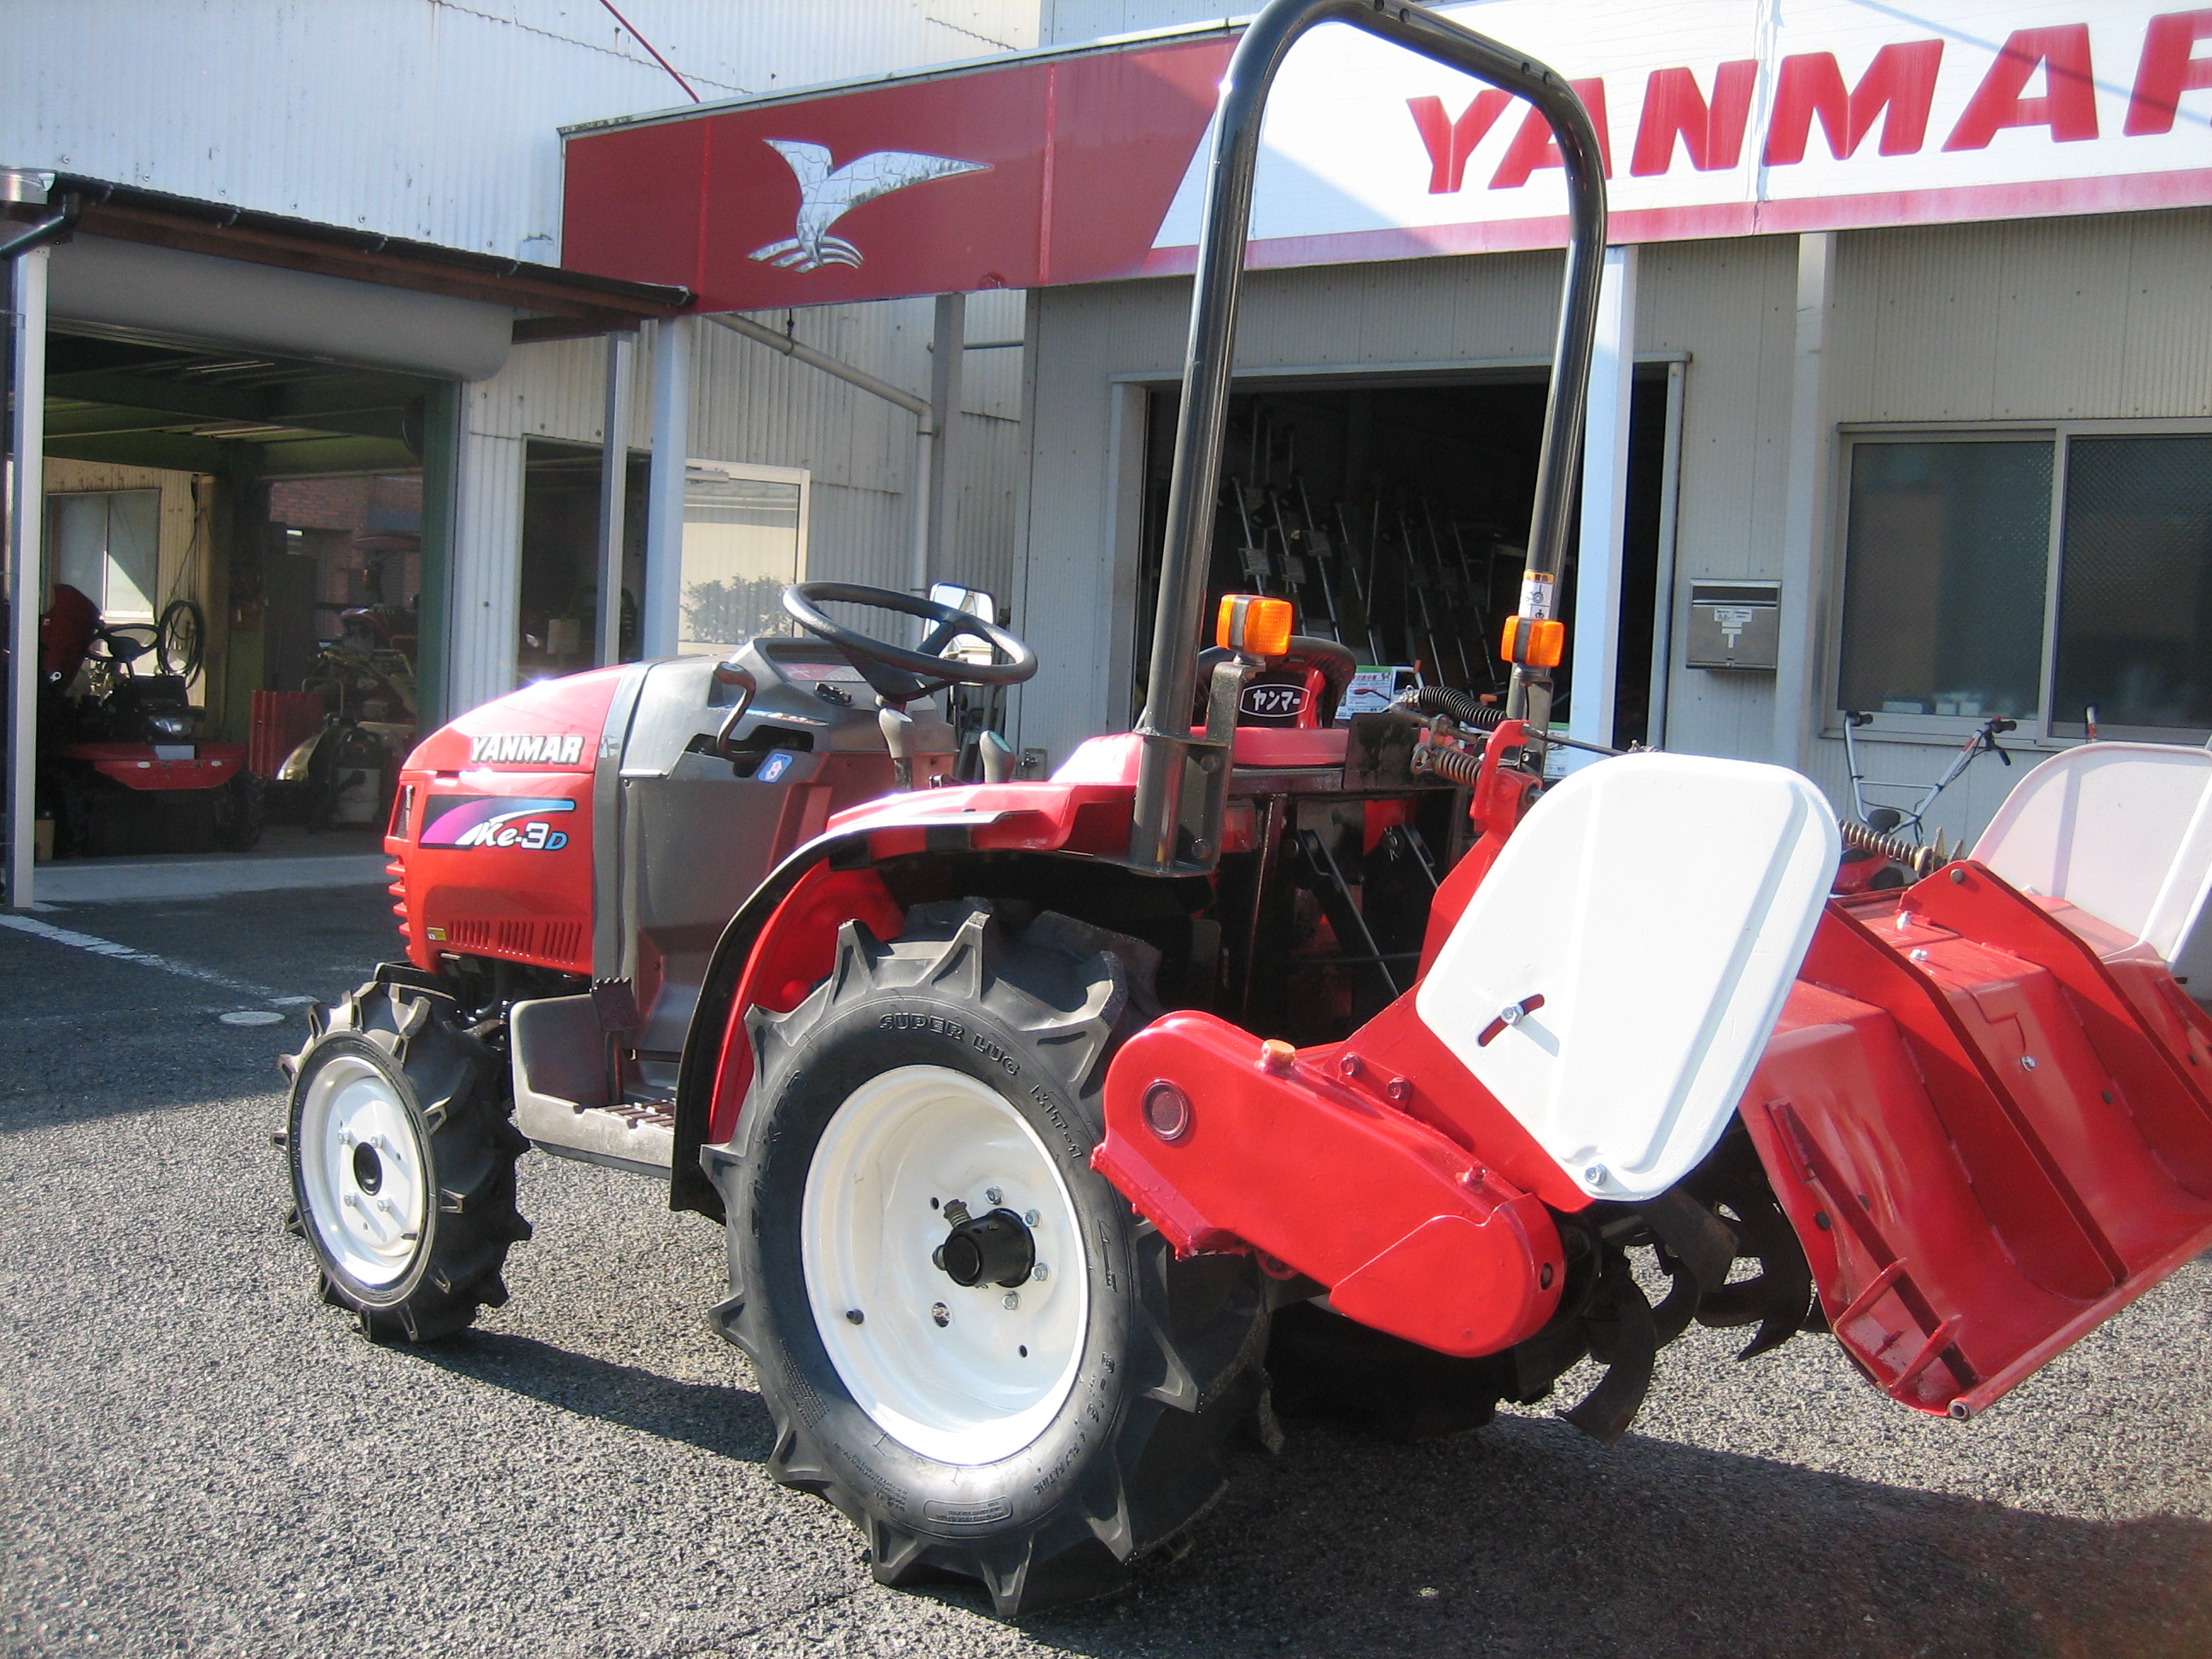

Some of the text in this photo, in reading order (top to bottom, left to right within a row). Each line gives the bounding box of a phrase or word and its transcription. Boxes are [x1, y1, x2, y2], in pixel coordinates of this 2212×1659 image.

[1253, 689, 1301, 711] ヤンマー
[470, 735, 585, 764] YANMAR
[879, 1012, 965, 1040] SUPER
[973, 1033, 1021, 1076] LUG
